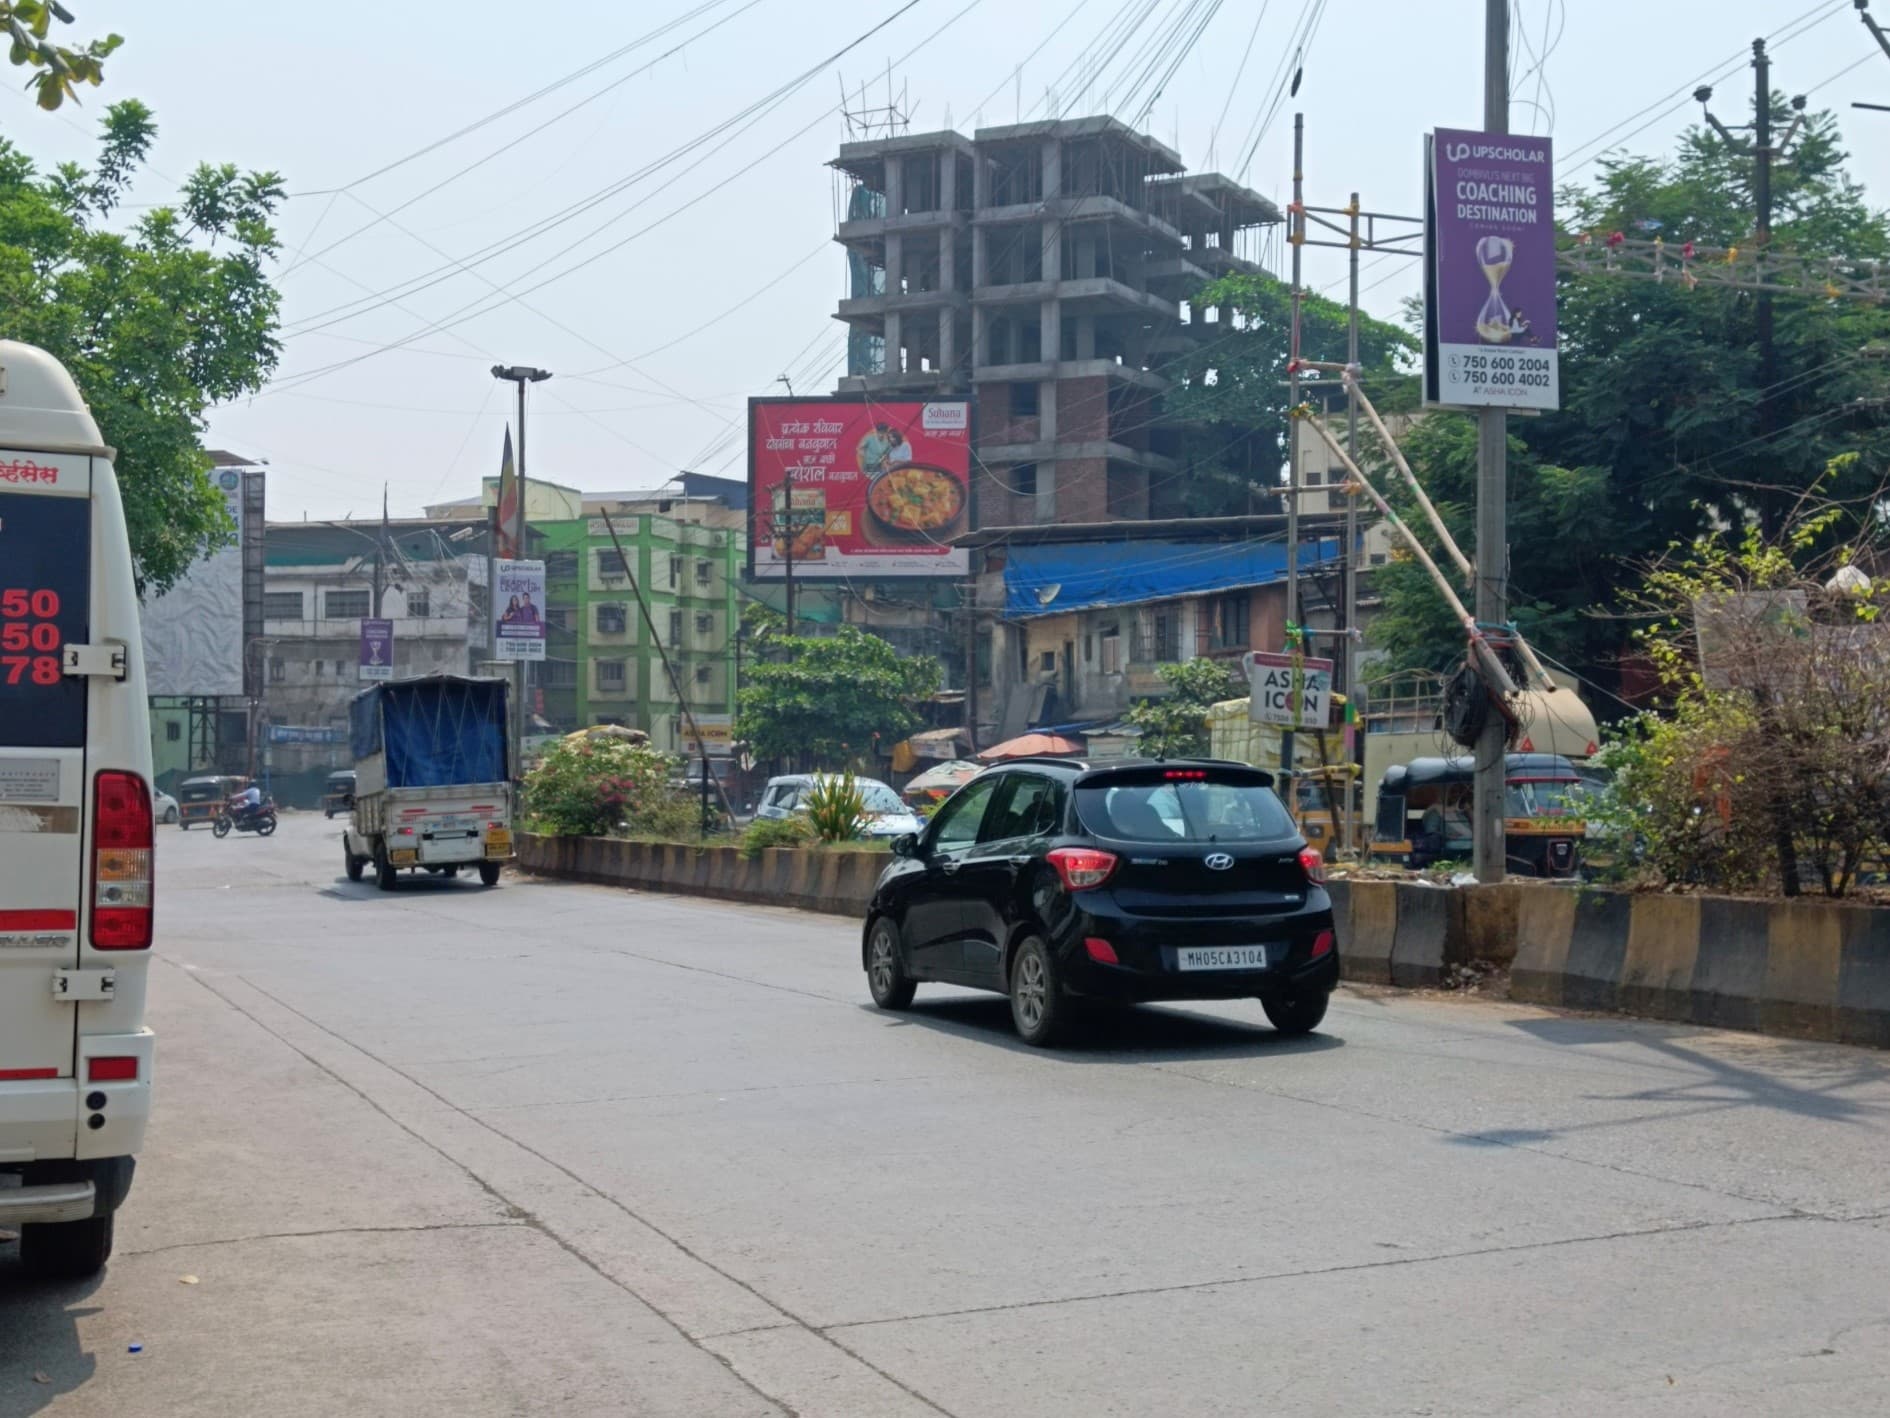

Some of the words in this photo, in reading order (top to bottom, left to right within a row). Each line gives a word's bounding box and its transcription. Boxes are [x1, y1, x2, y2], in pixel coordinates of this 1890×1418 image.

[1473, 146, 1545, 163] UPSCHOLAR
[1456, 181, 1537, 205] COACHING
[1457, 204, 1537, 224] DESTINATION
[1463, 355, 1487, 369] 750
[1491, 357, 1515, 371] 600
[1518, 358, 1550, 372] 2004
[1463, 370, 1487, 384] 750
[1491, 372, 1515, 385] 600
[1518, 374, 1550, 387] 4002
[928, 407, 961, 418] Suhana
[1187, 950, 1263, 967] MH05CA3104
